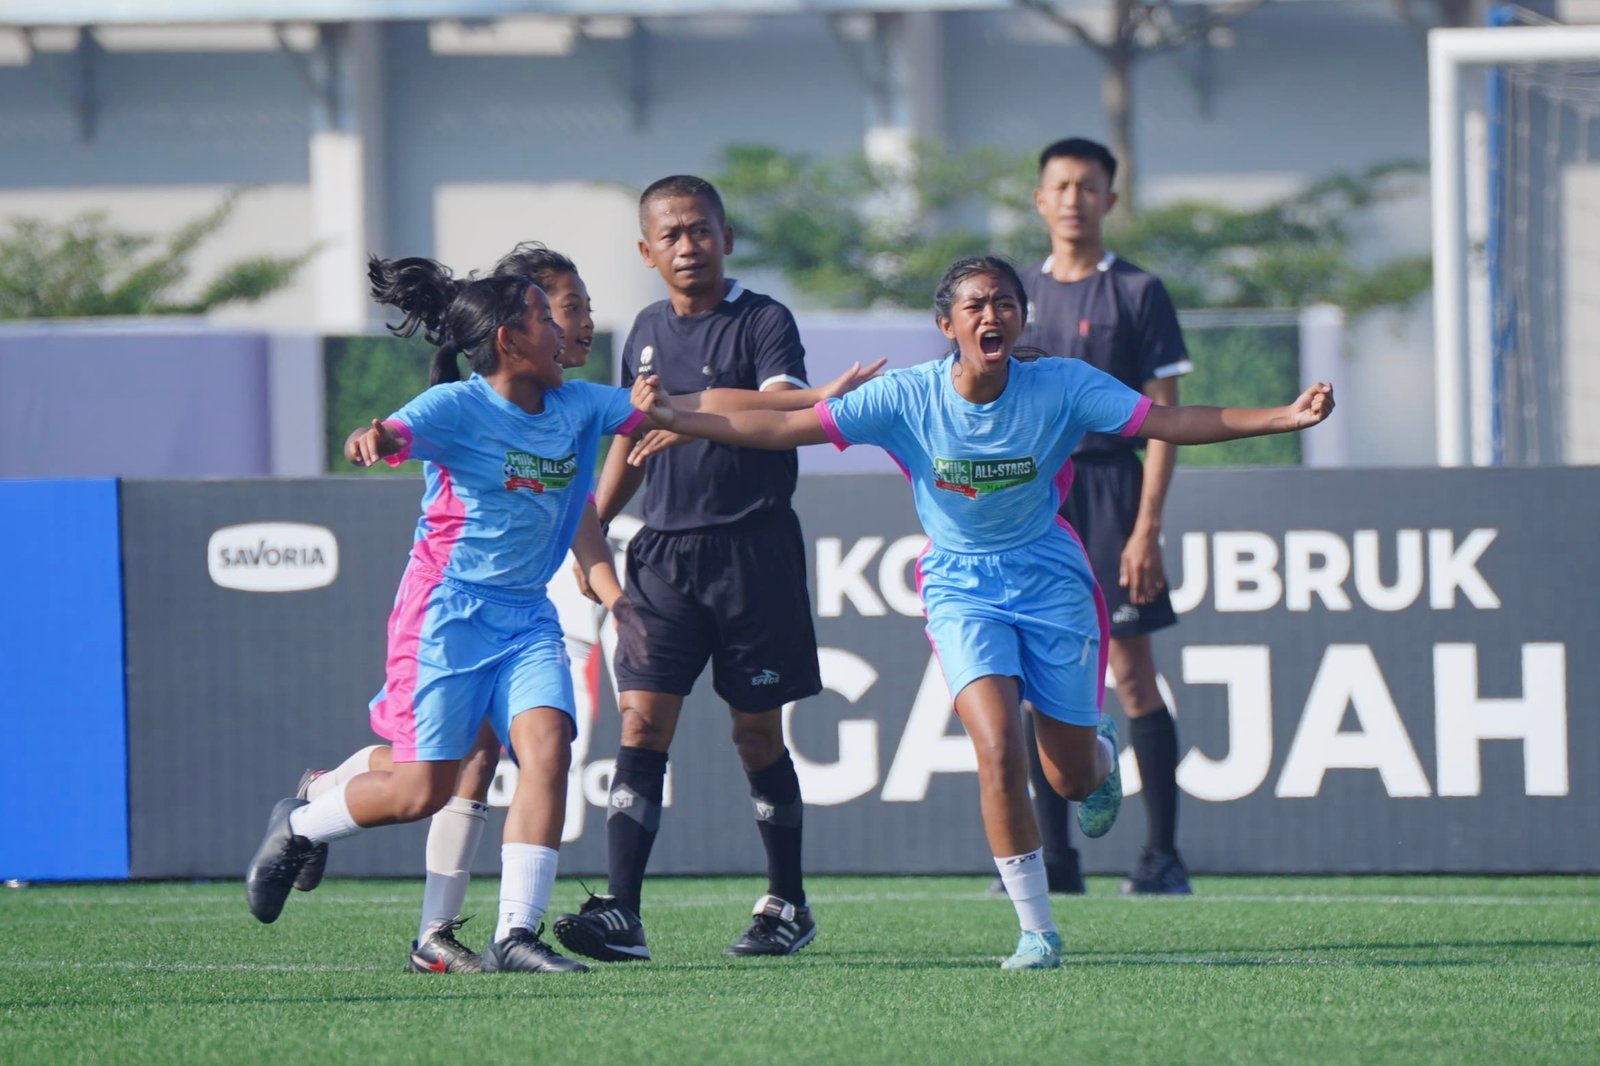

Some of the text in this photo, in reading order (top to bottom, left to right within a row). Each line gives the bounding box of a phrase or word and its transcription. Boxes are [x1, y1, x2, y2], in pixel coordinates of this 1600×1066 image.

[510, 453, 536, 467] Milk
[938, 460, 967, 474] Milk
[516, 466, 538, 479] Life
[943, 473, 970, 484] Life
[220, 539, 325, 568] SAVORIA
[816, 529, 1501, 617] KO UBRUK
[781, 642, 1568, 806] GAJAH
